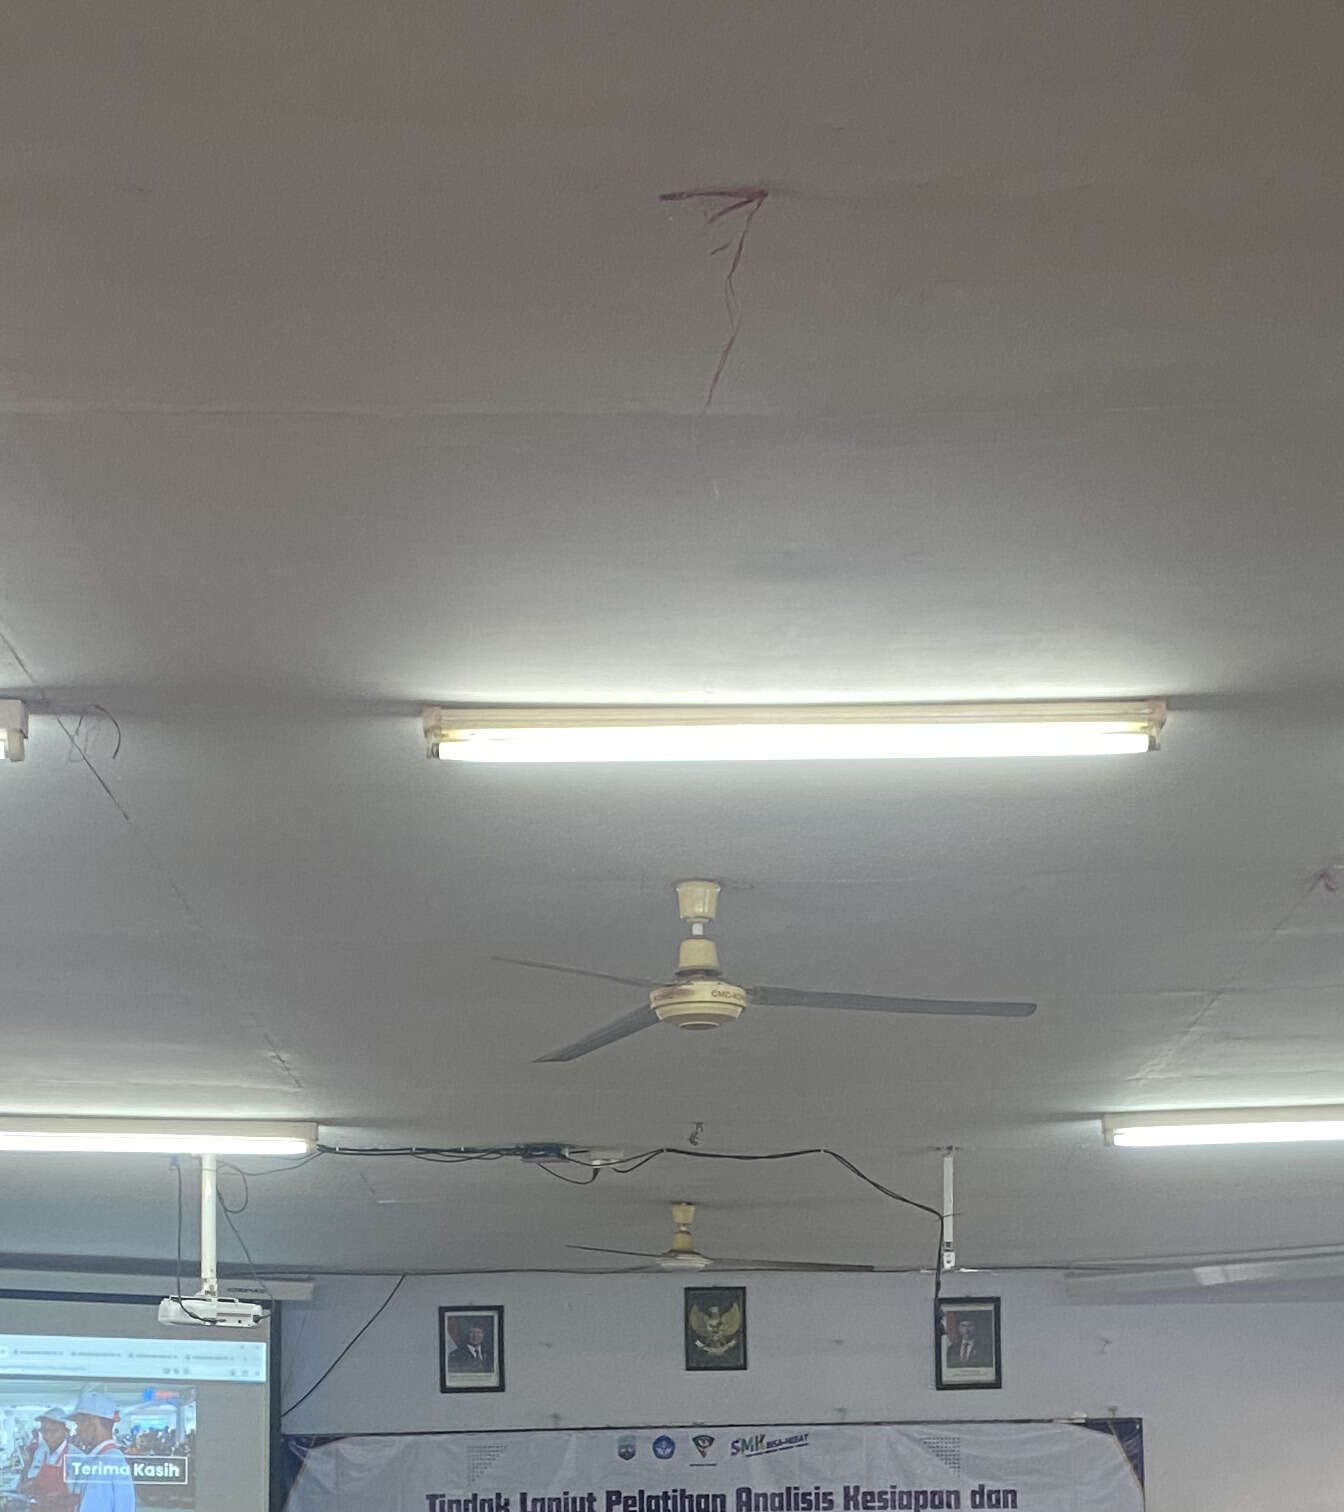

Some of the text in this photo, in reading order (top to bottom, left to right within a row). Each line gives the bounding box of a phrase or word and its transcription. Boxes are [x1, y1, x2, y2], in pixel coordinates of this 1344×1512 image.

[731, 1434, 766, 1456] SMK
[72, 1462, 180, 1477] Terima Kasih
[735, 1486, 835, 1512] Analisis
[970, 1484, 1018, 1510] dan
